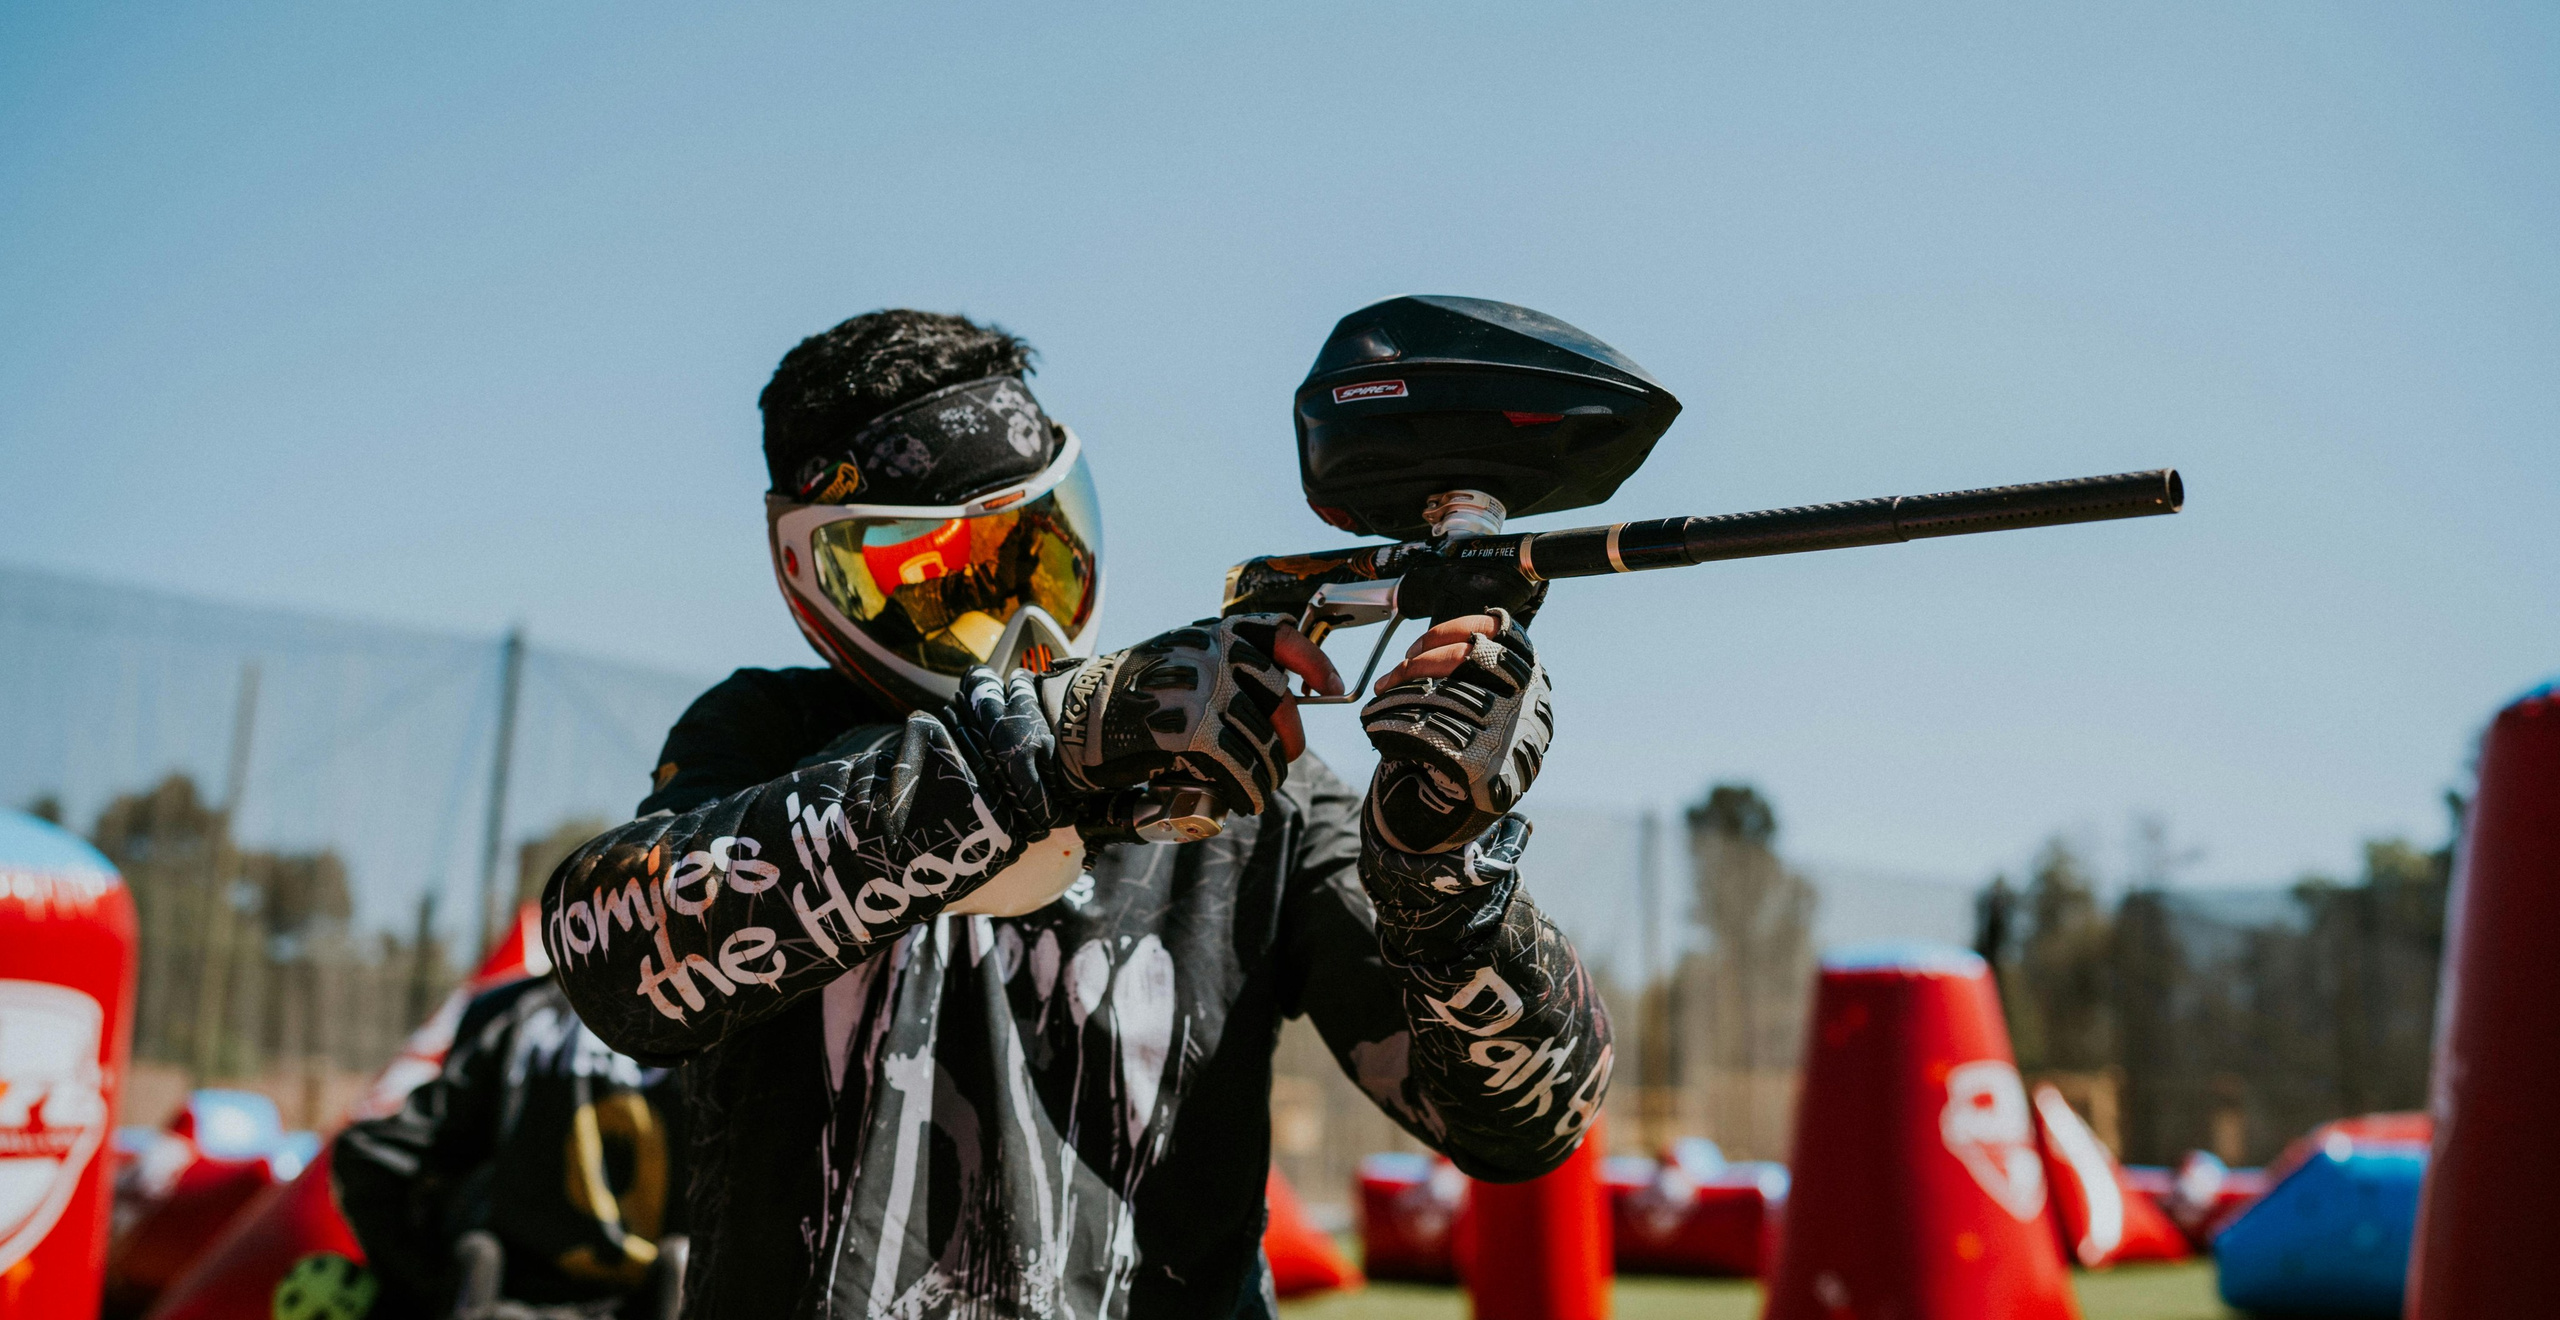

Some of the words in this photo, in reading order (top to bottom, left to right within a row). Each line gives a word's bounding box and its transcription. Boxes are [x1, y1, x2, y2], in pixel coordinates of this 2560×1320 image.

[1340, 385, 1388, 398] SPIRE
[1461, 549, 1477, 558] EAT
[1478, 548, 1493, 557] FOR
[1495, 547, 1515, 557] FREE
[786, 791, 860, 880] in
[637, 926, 787, 1026] the
[793, 793, 1012, 966] Hood
[1424, 966, 1578, 1119] Dark
